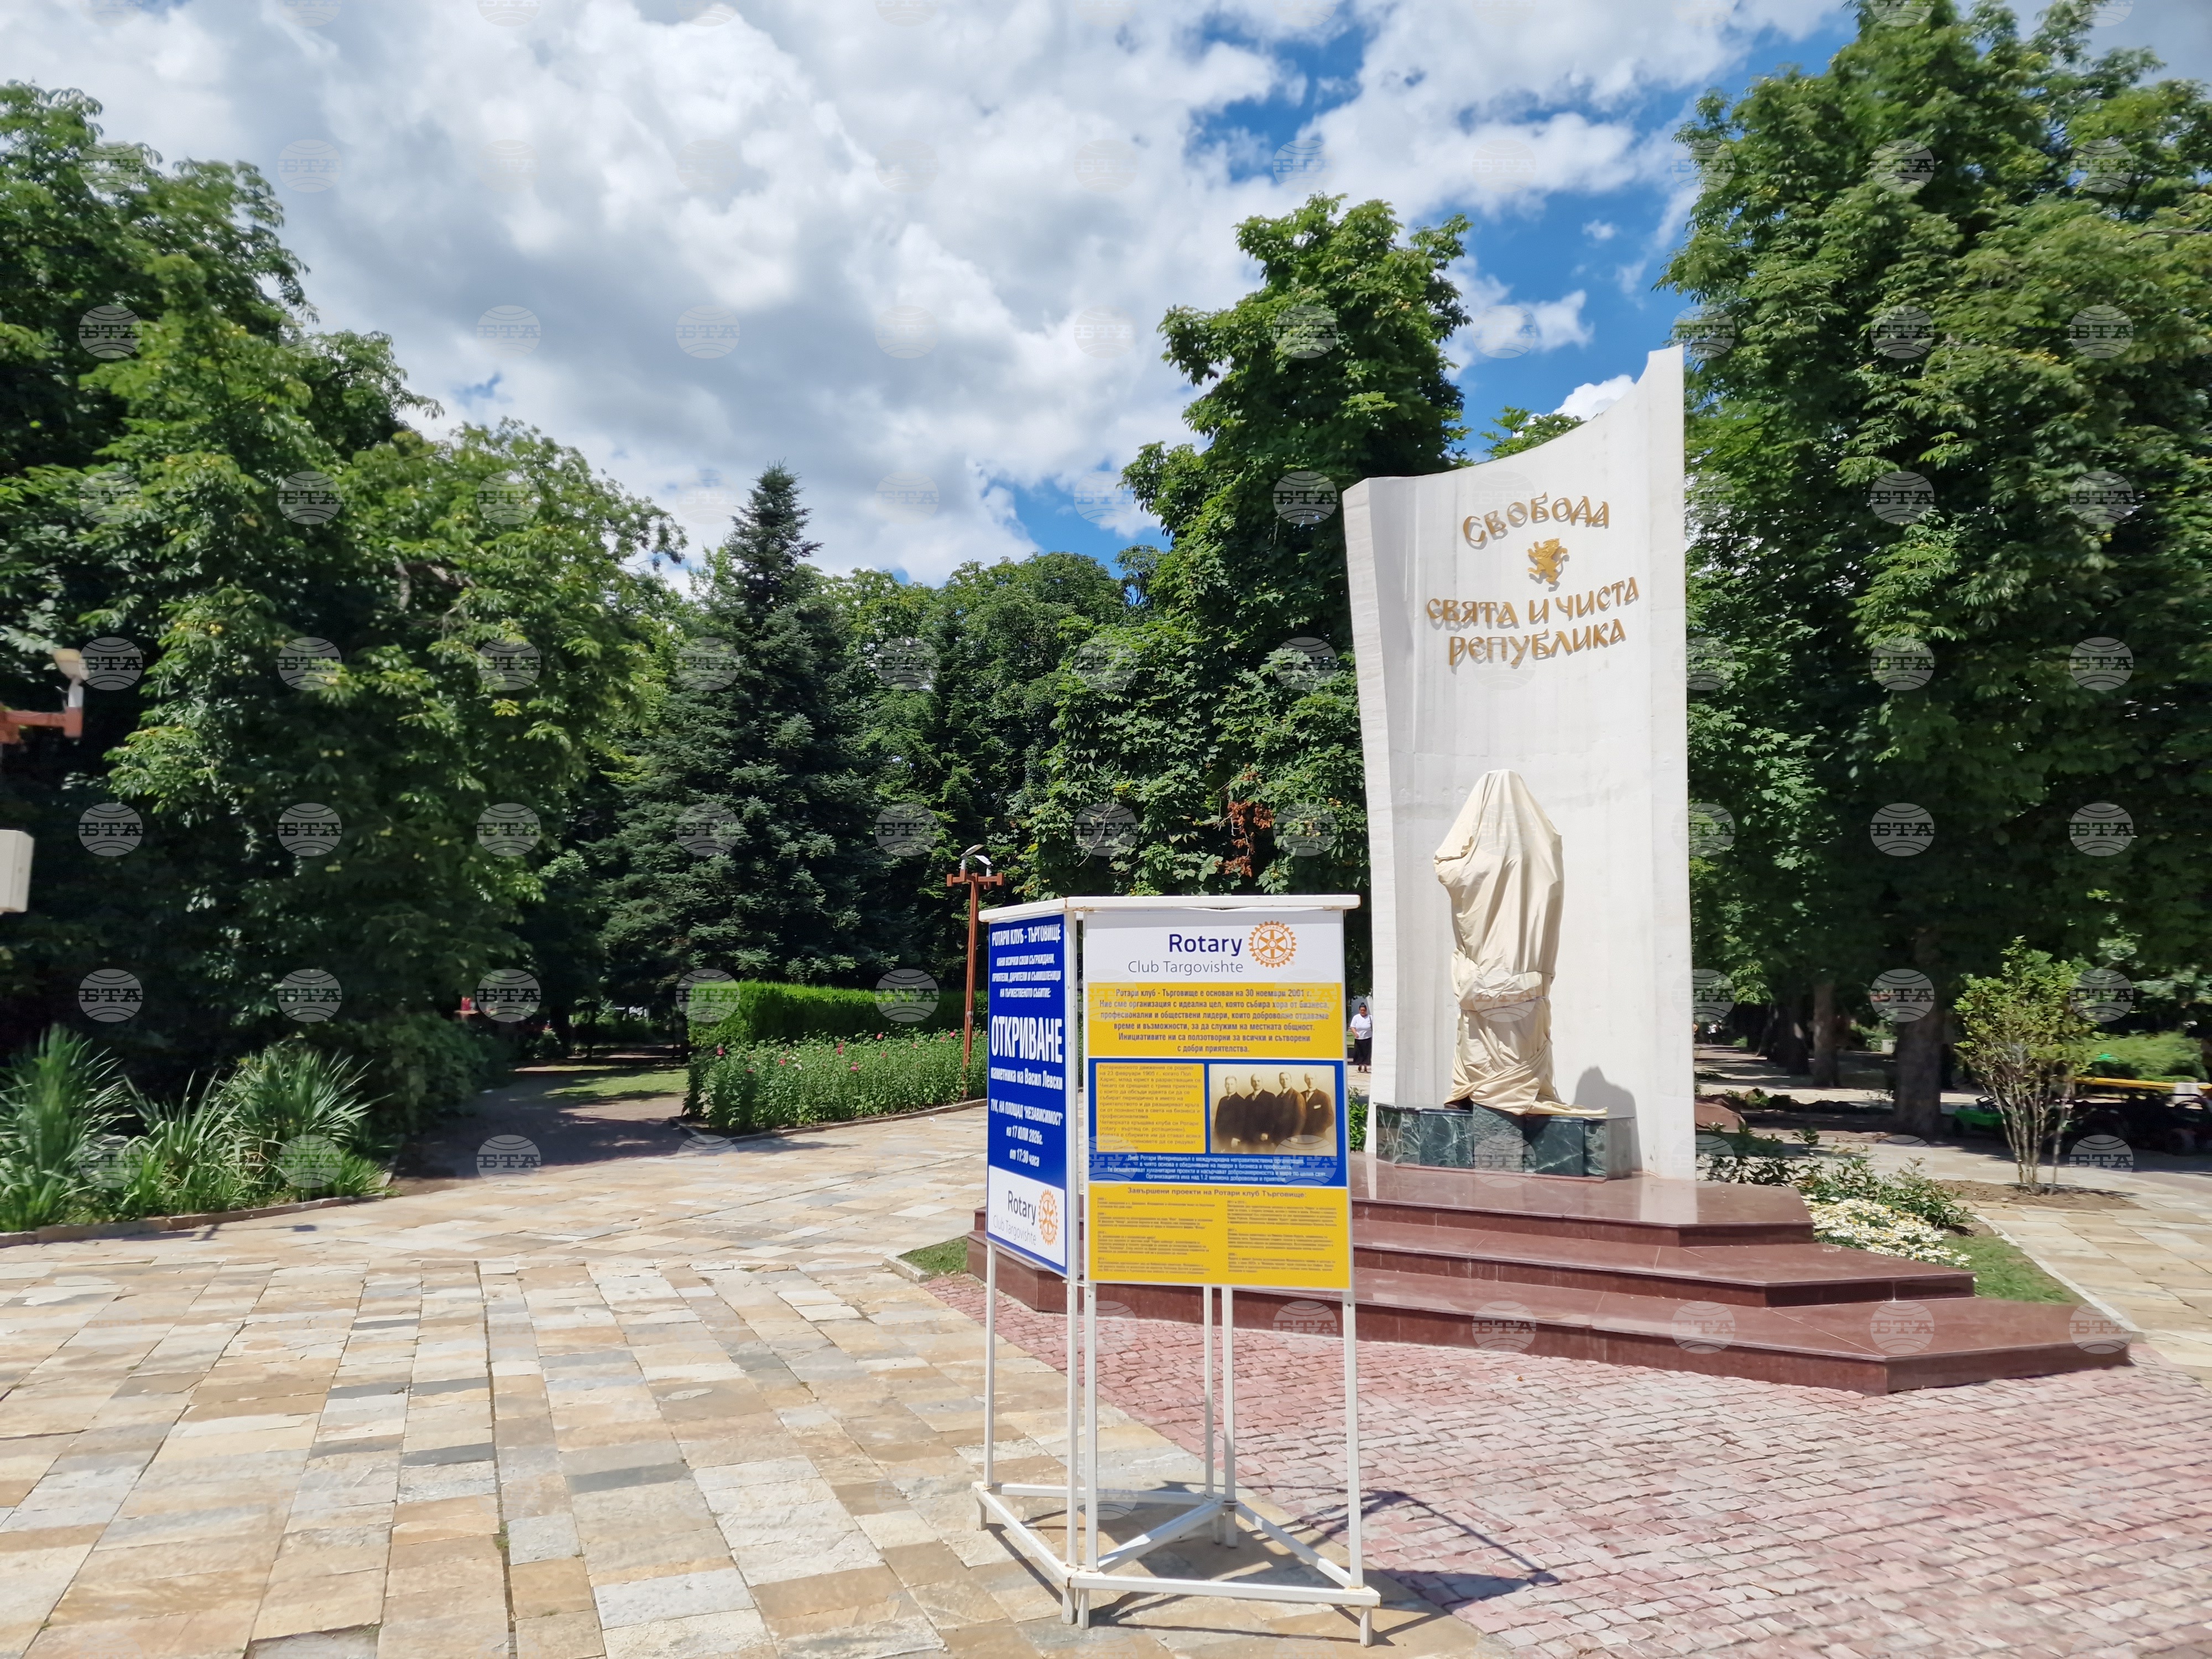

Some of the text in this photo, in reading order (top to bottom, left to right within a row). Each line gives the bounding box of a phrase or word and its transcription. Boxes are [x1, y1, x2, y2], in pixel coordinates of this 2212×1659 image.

[1463, 492, 1610, 542] СВОБОДА
[1427, 577, 1639, 624] СВЯТА И ЧИСТА
[1449, 618, 1626, 669] РЕПУБЛИКА
[992, 930, 1009, 946] РОТАРИ
[1010, 928, 1024, 944] КЛУБ
[1027, 924, 1061, 943] ТЪРГОВИЩЕ
[1169, 934, 1243, 957] Rotary
[1128, 961, 1244, 975] Club Targovishte
[1117, 989, 1139, 998] Ротари
[1141, 989, 1155, 998] клуб
[1162, 989, 1198, 998] Търговище
[1246, 1000, 1270, 1009] събира
[1161, 1011, 1201, 1019] обществени
[1252, 1011, 1293, 1021] доброволно
[991, 1015, 1063, 1063] ОТКРИВАНЕ
[1119, 1032, 1166, 1041] Инициативите
[1183, 1044, 1203, 1053] добри
[990, 1067, 1063, 1091] паметника на Васил Левски
[999, 1100, 1005, 1113] НА
[1005, 1101, 1023, 1120] ПЛОЩАД
[1006, 1126, 1011, 1136] на
[1012, 1125, 1017, 1138] 17
[1018, 1126, 1029, 1141] ЮЛИ
[1029, 1155, 1040, 1167] часа
[1262, 1189, 1307, 1198] Търговище:
[1008, 1190, 1036, 1226] Rotary
[993, 1215, 1036, 1245] Club Targovishte
